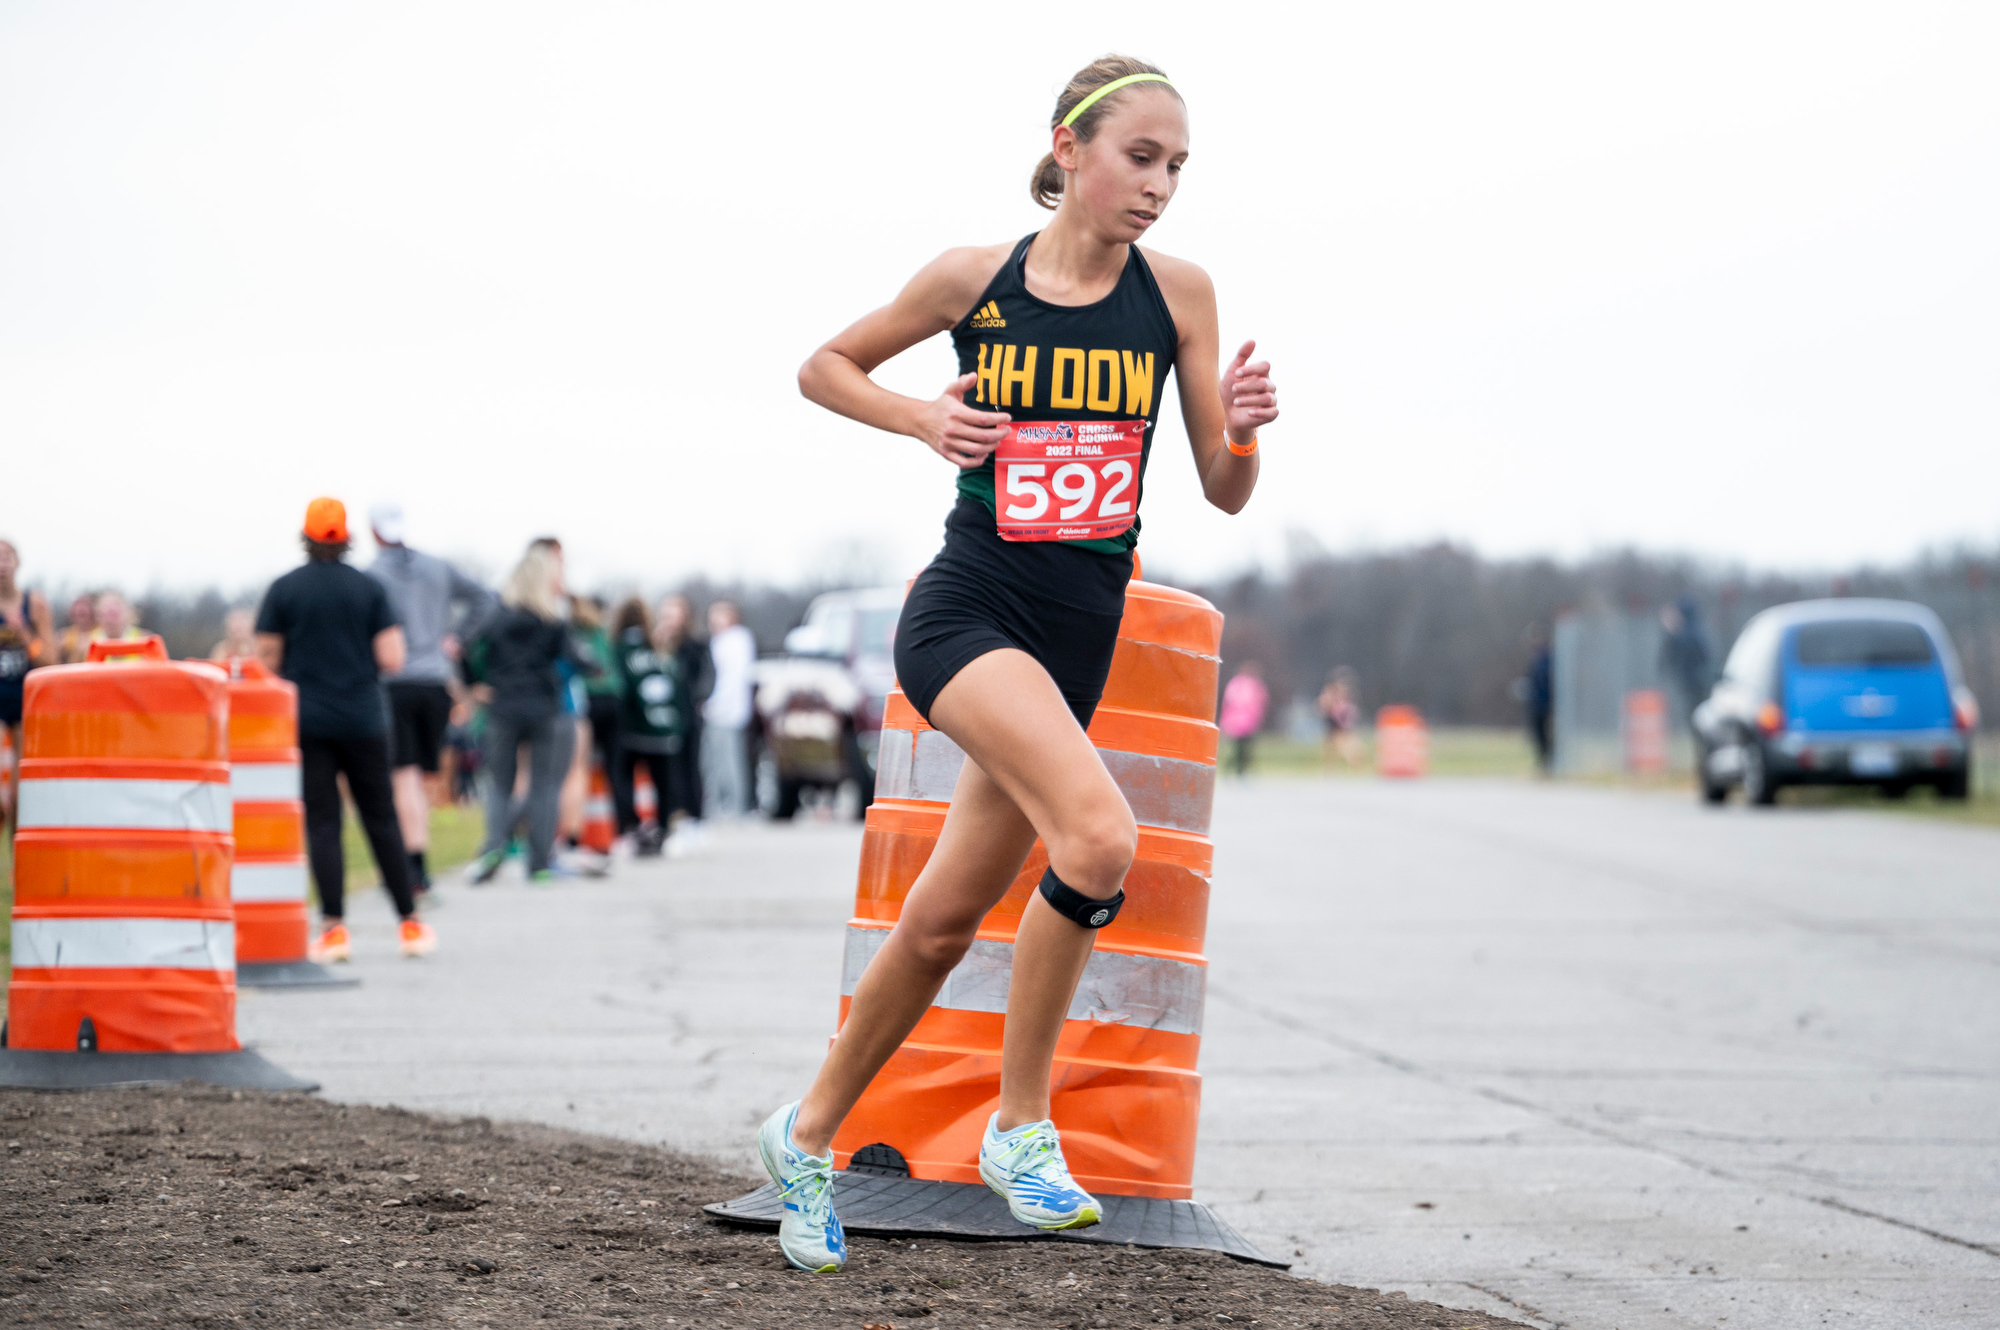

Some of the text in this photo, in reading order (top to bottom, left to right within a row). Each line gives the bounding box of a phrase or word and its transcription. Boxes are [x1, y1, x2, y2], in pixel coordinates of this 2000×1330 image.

[970, 317, 1006, 329] adidas
[975, 343, 1155, 417] HH DOW
[1017, 425, 1115, 440] MHSAA CROSS
[1078, 431, 1125, 444] COUNTRY
[1046, 445, 1104, 456] 2022 FINAL
[1005, 459, 1133, 521] 592
